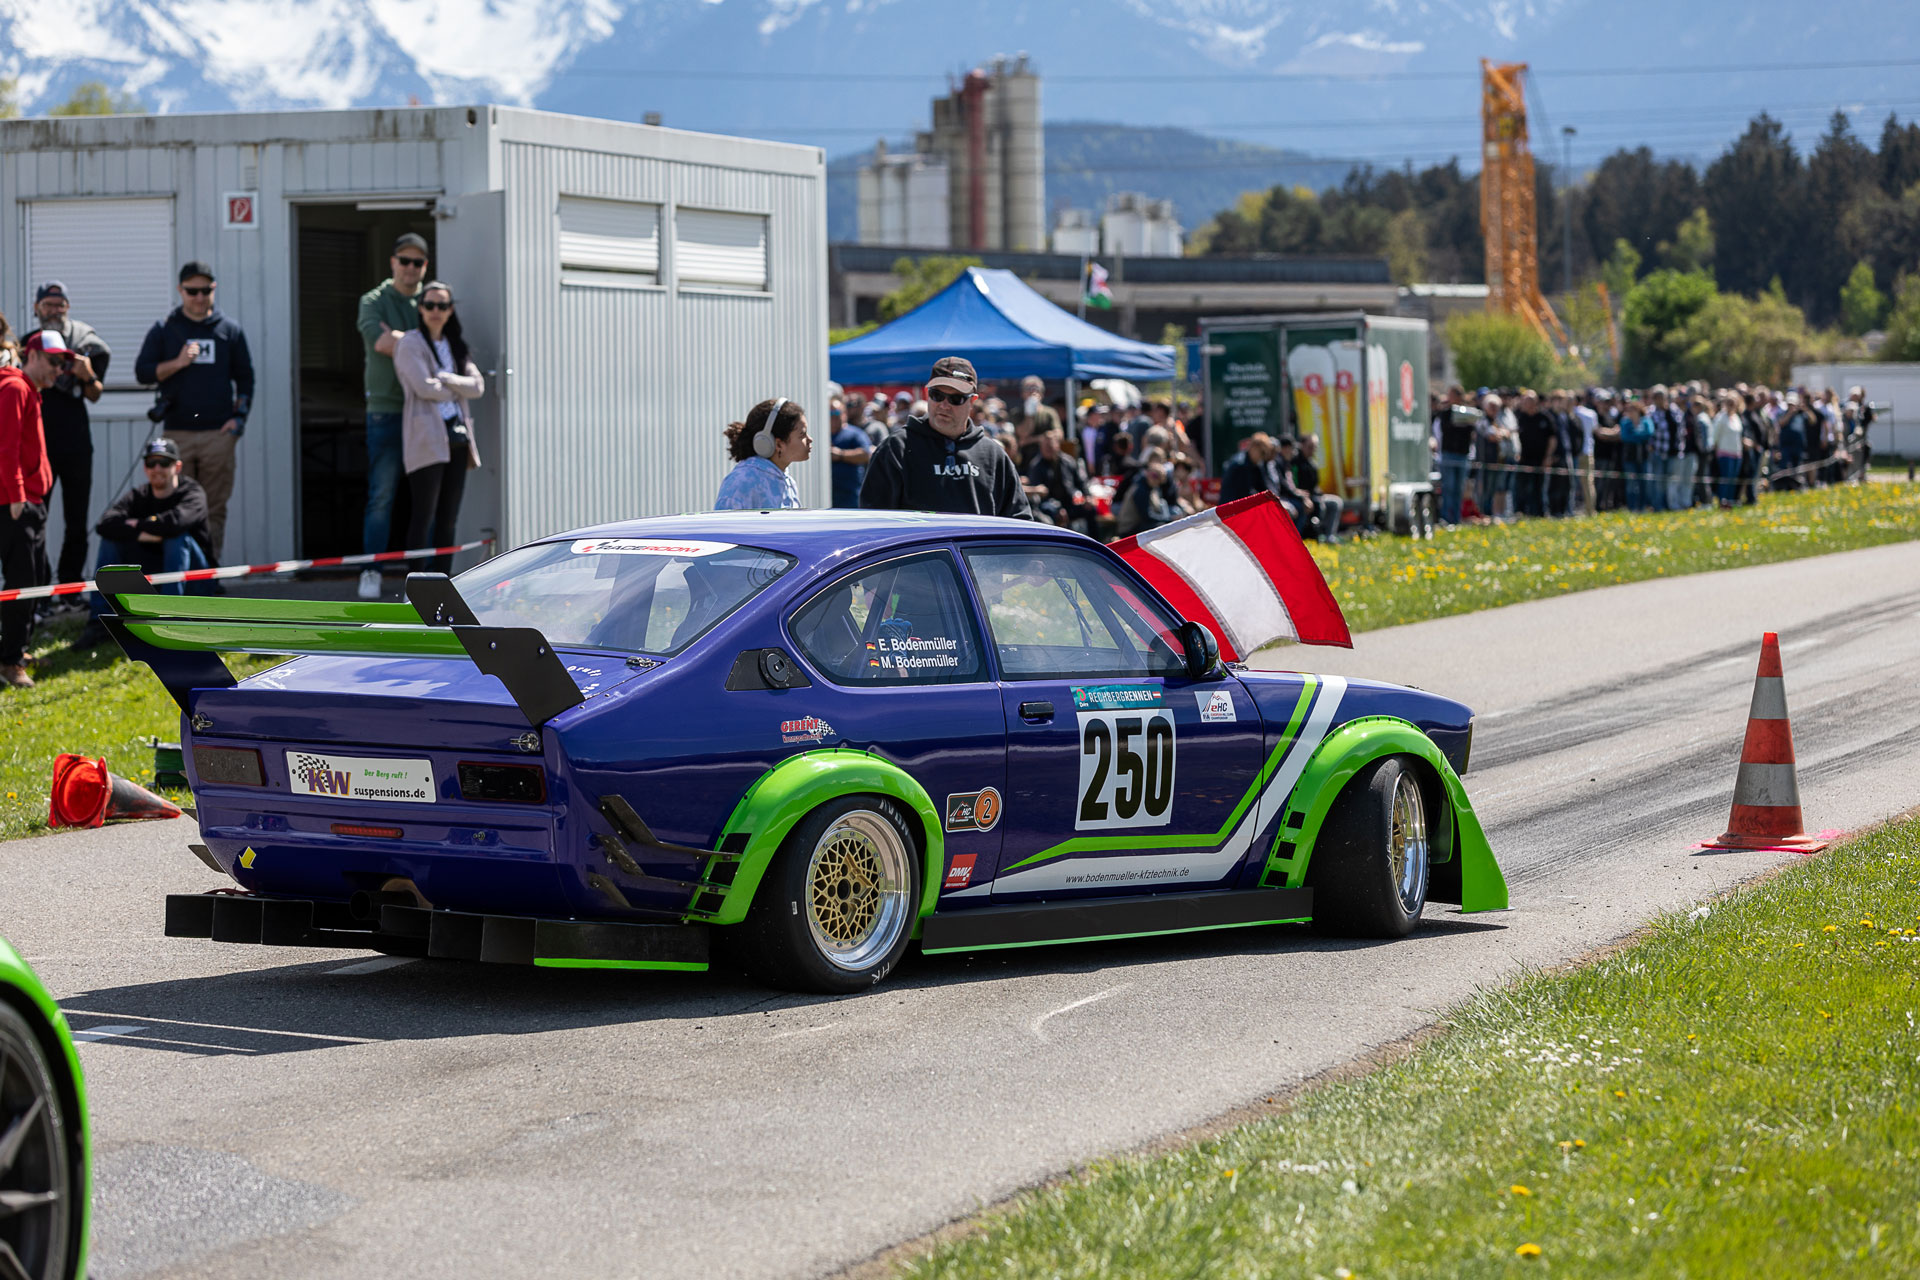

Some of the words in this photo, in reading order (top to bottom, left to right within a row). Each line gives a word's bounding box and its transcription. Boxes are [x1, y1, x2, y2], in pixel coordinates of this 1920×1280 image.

[596, 545, 700, 553] RACEROOM
[878, 639, 890, 651] E.
[891, 637, 957, 651] Bodenmüller
[880, 656, 894, 669] M.
[895, 654, 959, 668] Bodenmüller
[1088, 690, 1153, 703] RECHBERGRENNEN
[1211, 702, 1228, 712] eHC
[781, 719, 819, 733] GERENT
[364, 768, 375, 777] Der
[376, 769, 390, 780] Berg
[391, 771, 403, 779] ruft
[1080, 716, 1173, 821] 250
[307, 768, 351, 796] KW
[354, 787, 426, 799] suspensions.de
[982, 797, 993, 820] 2
[1066, 867, 1189, 884] www.bodenmueller-kfztechnik.de
